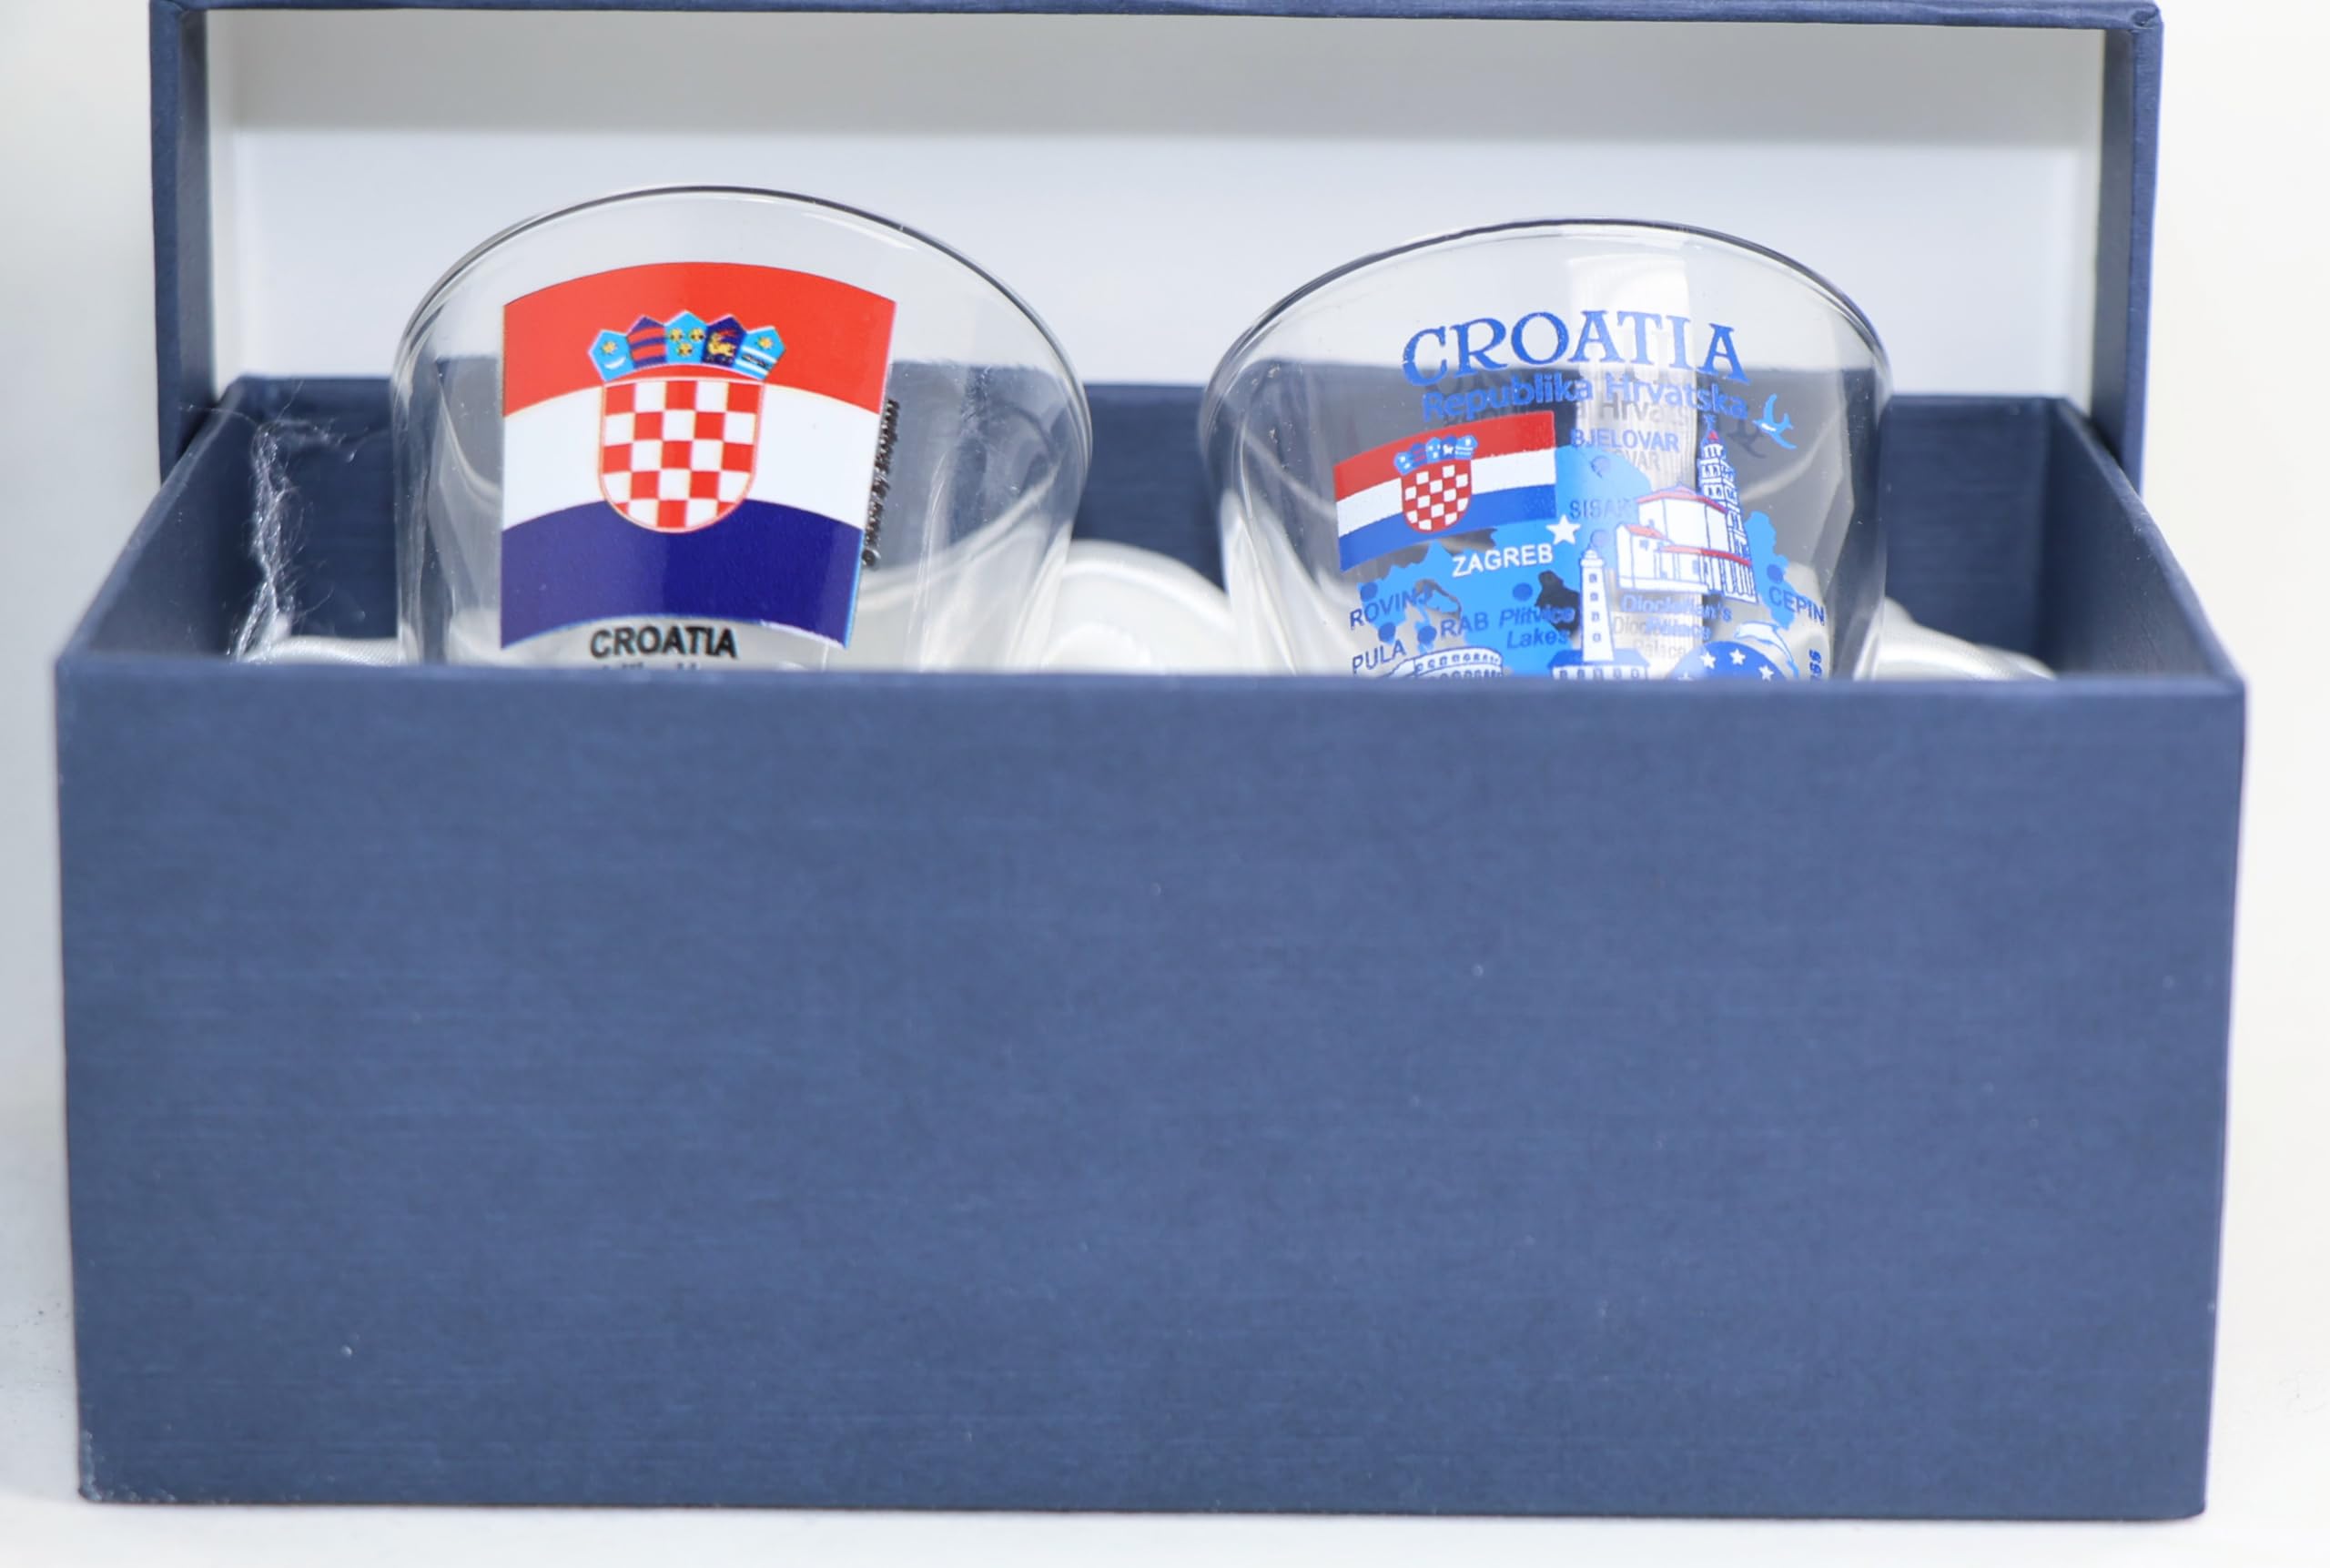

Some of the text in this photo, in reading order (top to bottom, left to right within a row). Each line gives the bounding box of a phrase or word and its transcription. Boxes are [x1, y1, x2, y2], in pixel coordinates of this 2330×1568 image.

[1403, 309, 1750, 386] CROATIA
[1423, 372, 1748, 422] Republika Hrvatska
[1570, 429, 1679, 451] BJELOVAR
[1452, 543, 1553, 578] ZAGREB
[1350, 583, 1433, 630] ROVINJ
[1499, 604, 1576, 628] Plitvice
[1769, 585, 1825, 626] CEPIN
[590, 624, 738, 659] CROATIA
[1440, 612, 1489, 639] RAB
[1507, 627, 1571, 649] Lakes
[1352, 639, 1407, 675] PULA
